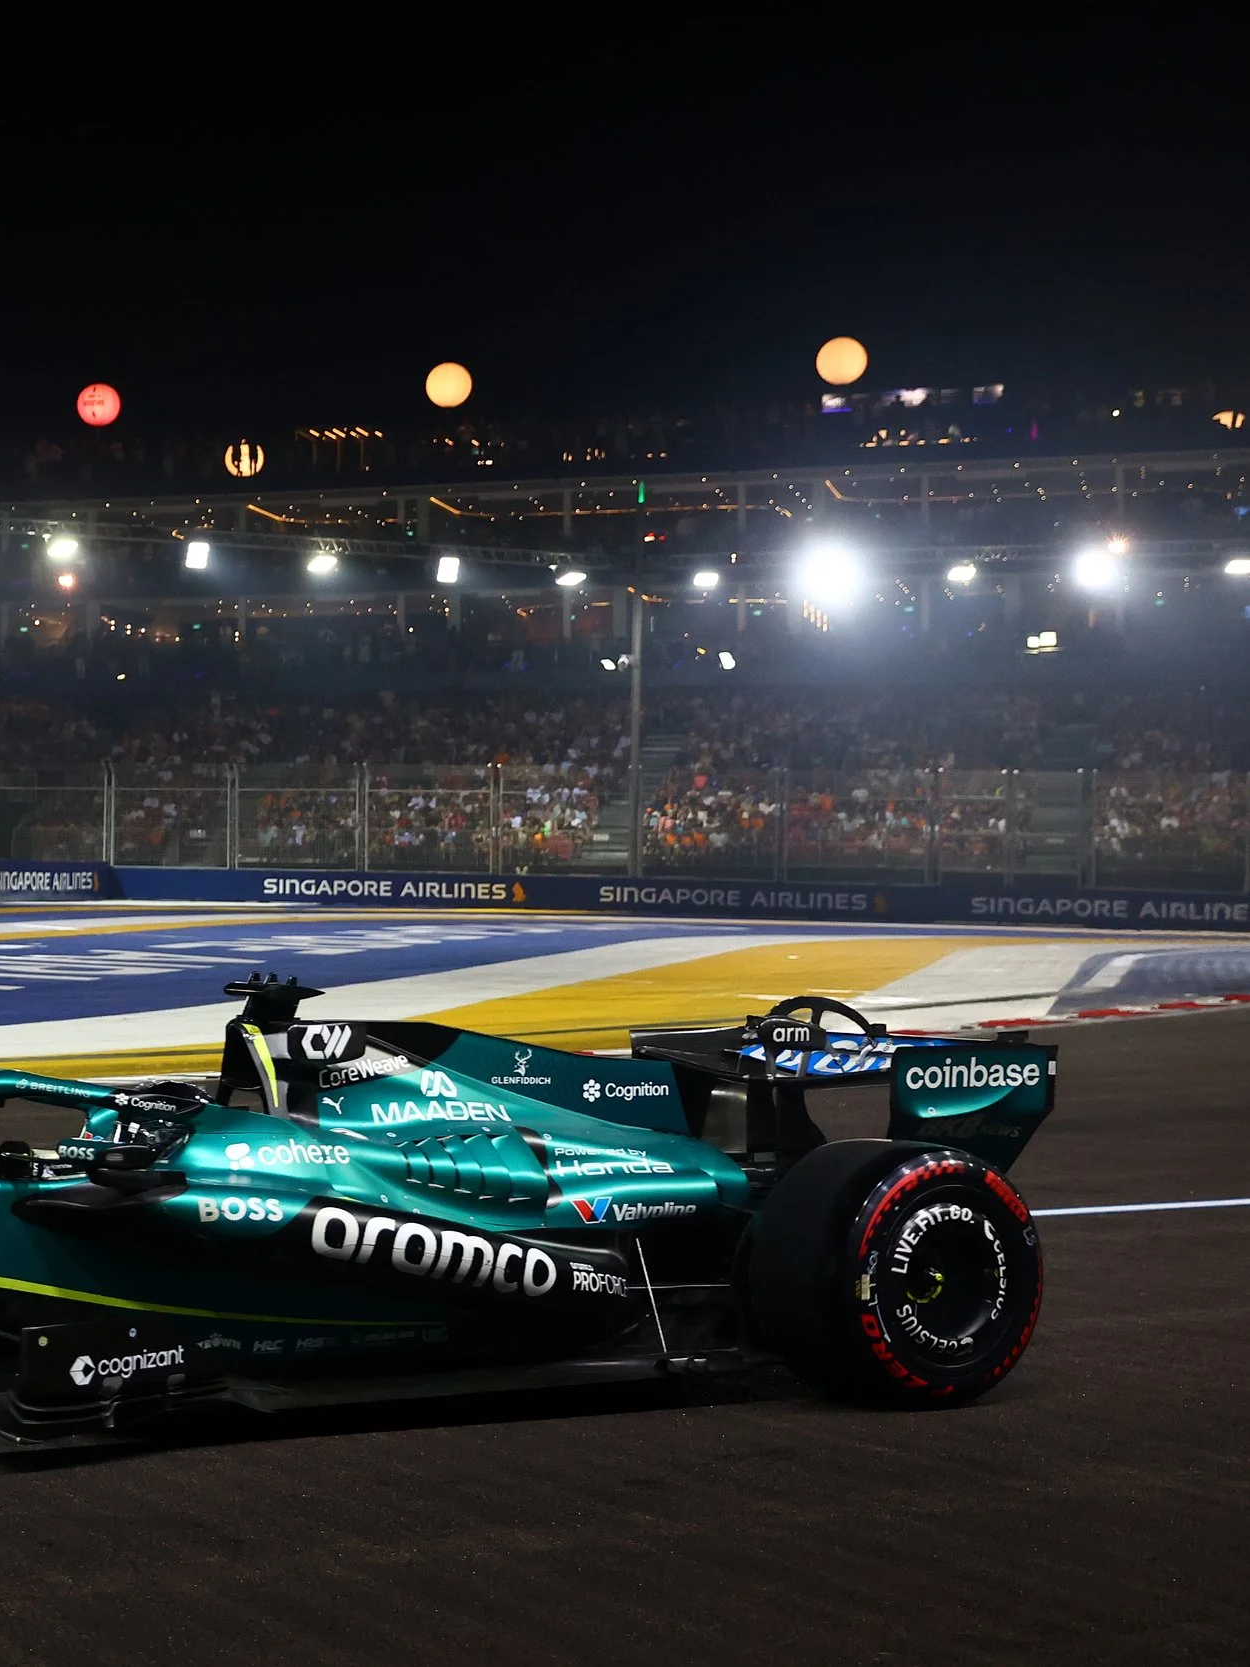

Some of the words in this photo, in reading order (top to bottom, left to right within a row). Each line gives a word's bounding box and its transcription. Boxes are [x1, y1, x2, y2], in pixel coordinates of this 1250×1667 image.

[52, 870, 94, 891] AIRLINES
[263, 878, 393, 897] SINGAPORE
[401, 880, 507, 900] AIRLINES
[599, 886, 740, 907] SINGAPORE
[751, 890, 867, 911] AIRLINES
[971, 896, 1127, 919] SINGAPORE
[772, 1025, 810, 1043] arm
[318, 1053, 409, 1090] CoreWeave
[491, 1075, 551, 1085] GLENFIDDICH
[906, 1057, 1040, 1090] coinbase
[30, 1082, 91, 1099] BREITLING
[605, 1082, 669, 1098] Cognition
[131, 1097, 177, 1113] Cognition
[371, 1103, 511, 1123] MAADEN
[58, 1144, 95, 1161] BOSS
[258, 1138, 350, 1165] cohere
[554, 1148, 626, 1157] Powered
[629, 1149, 646, 1157] by
[555, 1160, 675, 1177] Honda
[198, 1196, 284, 1222] BOSS
[612, 1201, 697, 1222] Valvoline
[312, 1206, 556, 1297] aramco
[98, 1345, 185, 1378] cognizant
